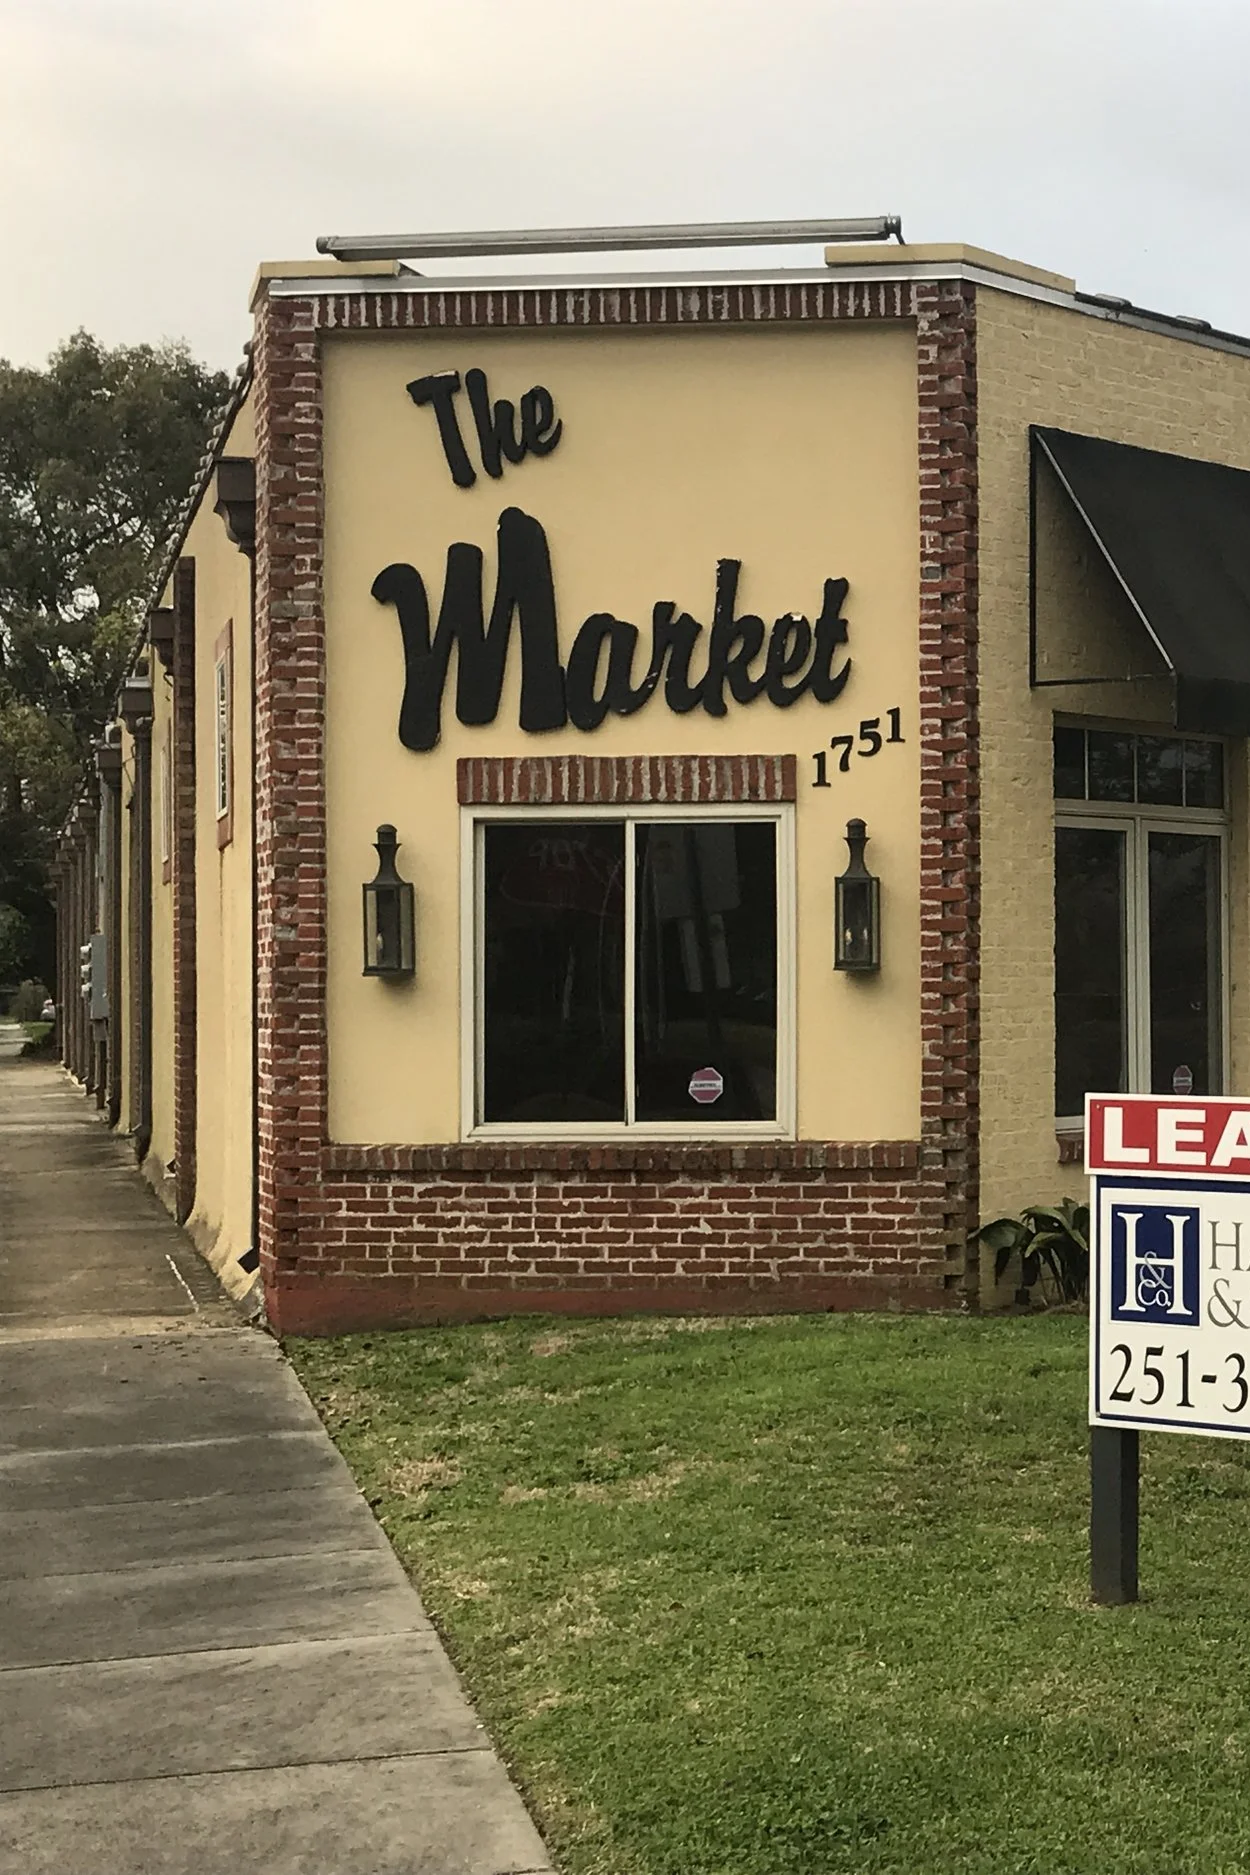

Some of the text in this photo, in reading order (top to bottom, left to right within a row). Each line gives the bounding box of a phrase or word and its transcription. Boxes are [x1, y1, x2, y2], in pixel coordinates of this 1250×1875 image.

[406, 368, 562, 488] The
[370, 506, 852, 752] Market
[811, 707, 906, 787] 1751
